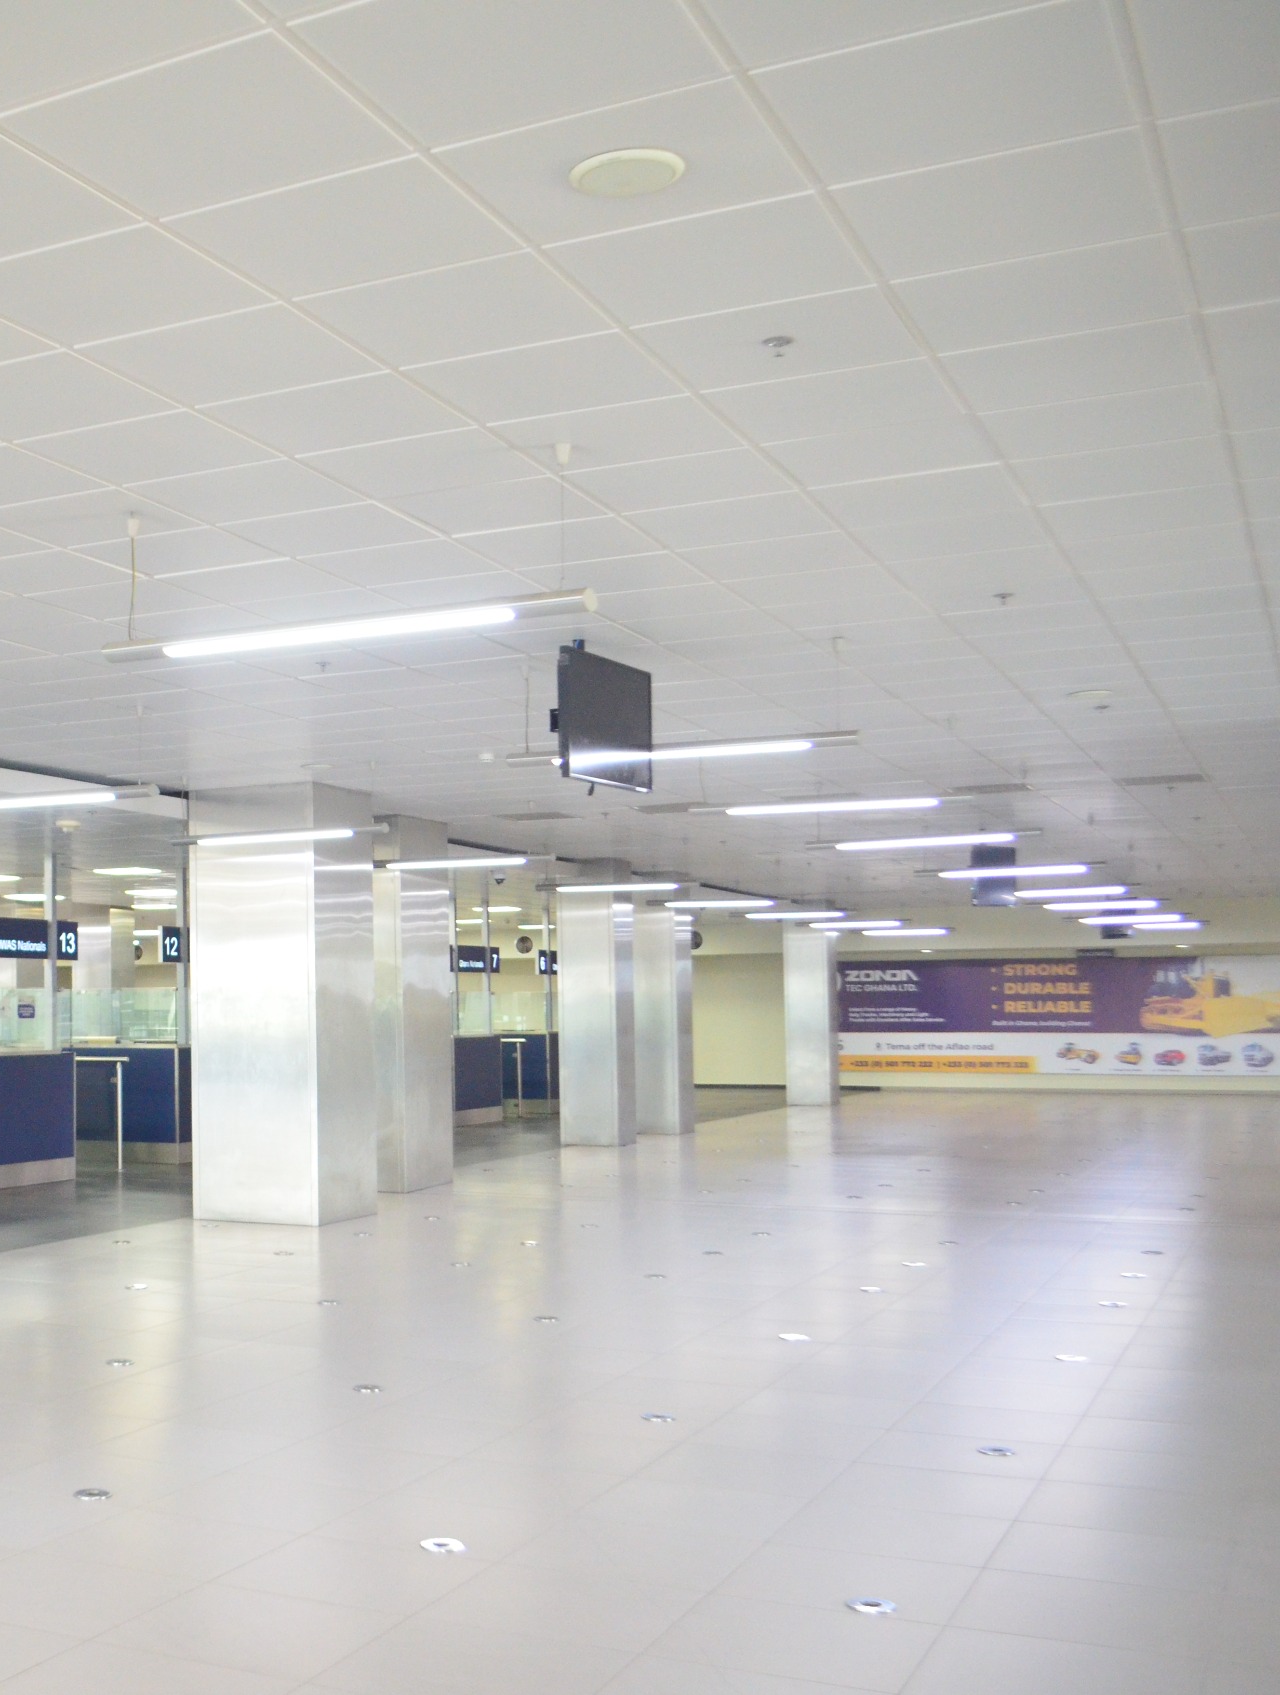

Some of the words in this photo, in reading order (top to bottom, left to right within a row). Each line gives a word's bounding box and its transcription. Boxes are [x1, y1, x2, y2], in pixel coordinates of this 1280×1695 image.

[17, 939, 47, 952] Nationals
[59, 932, 76, 954] 13
[164, 936, 178, 956] 12
[492, 954, 498, 968] 7
[1003, 964, 1077, 976] STRONG
[845, 984, 862, 992] TEC
[864, 984, 897, 992] GHANA
[1003, 982, 1091, 994] DURABLE
[1003, 1000, 1092, 1013] RELIABLE
[972, 1043, 994, 1051] road
